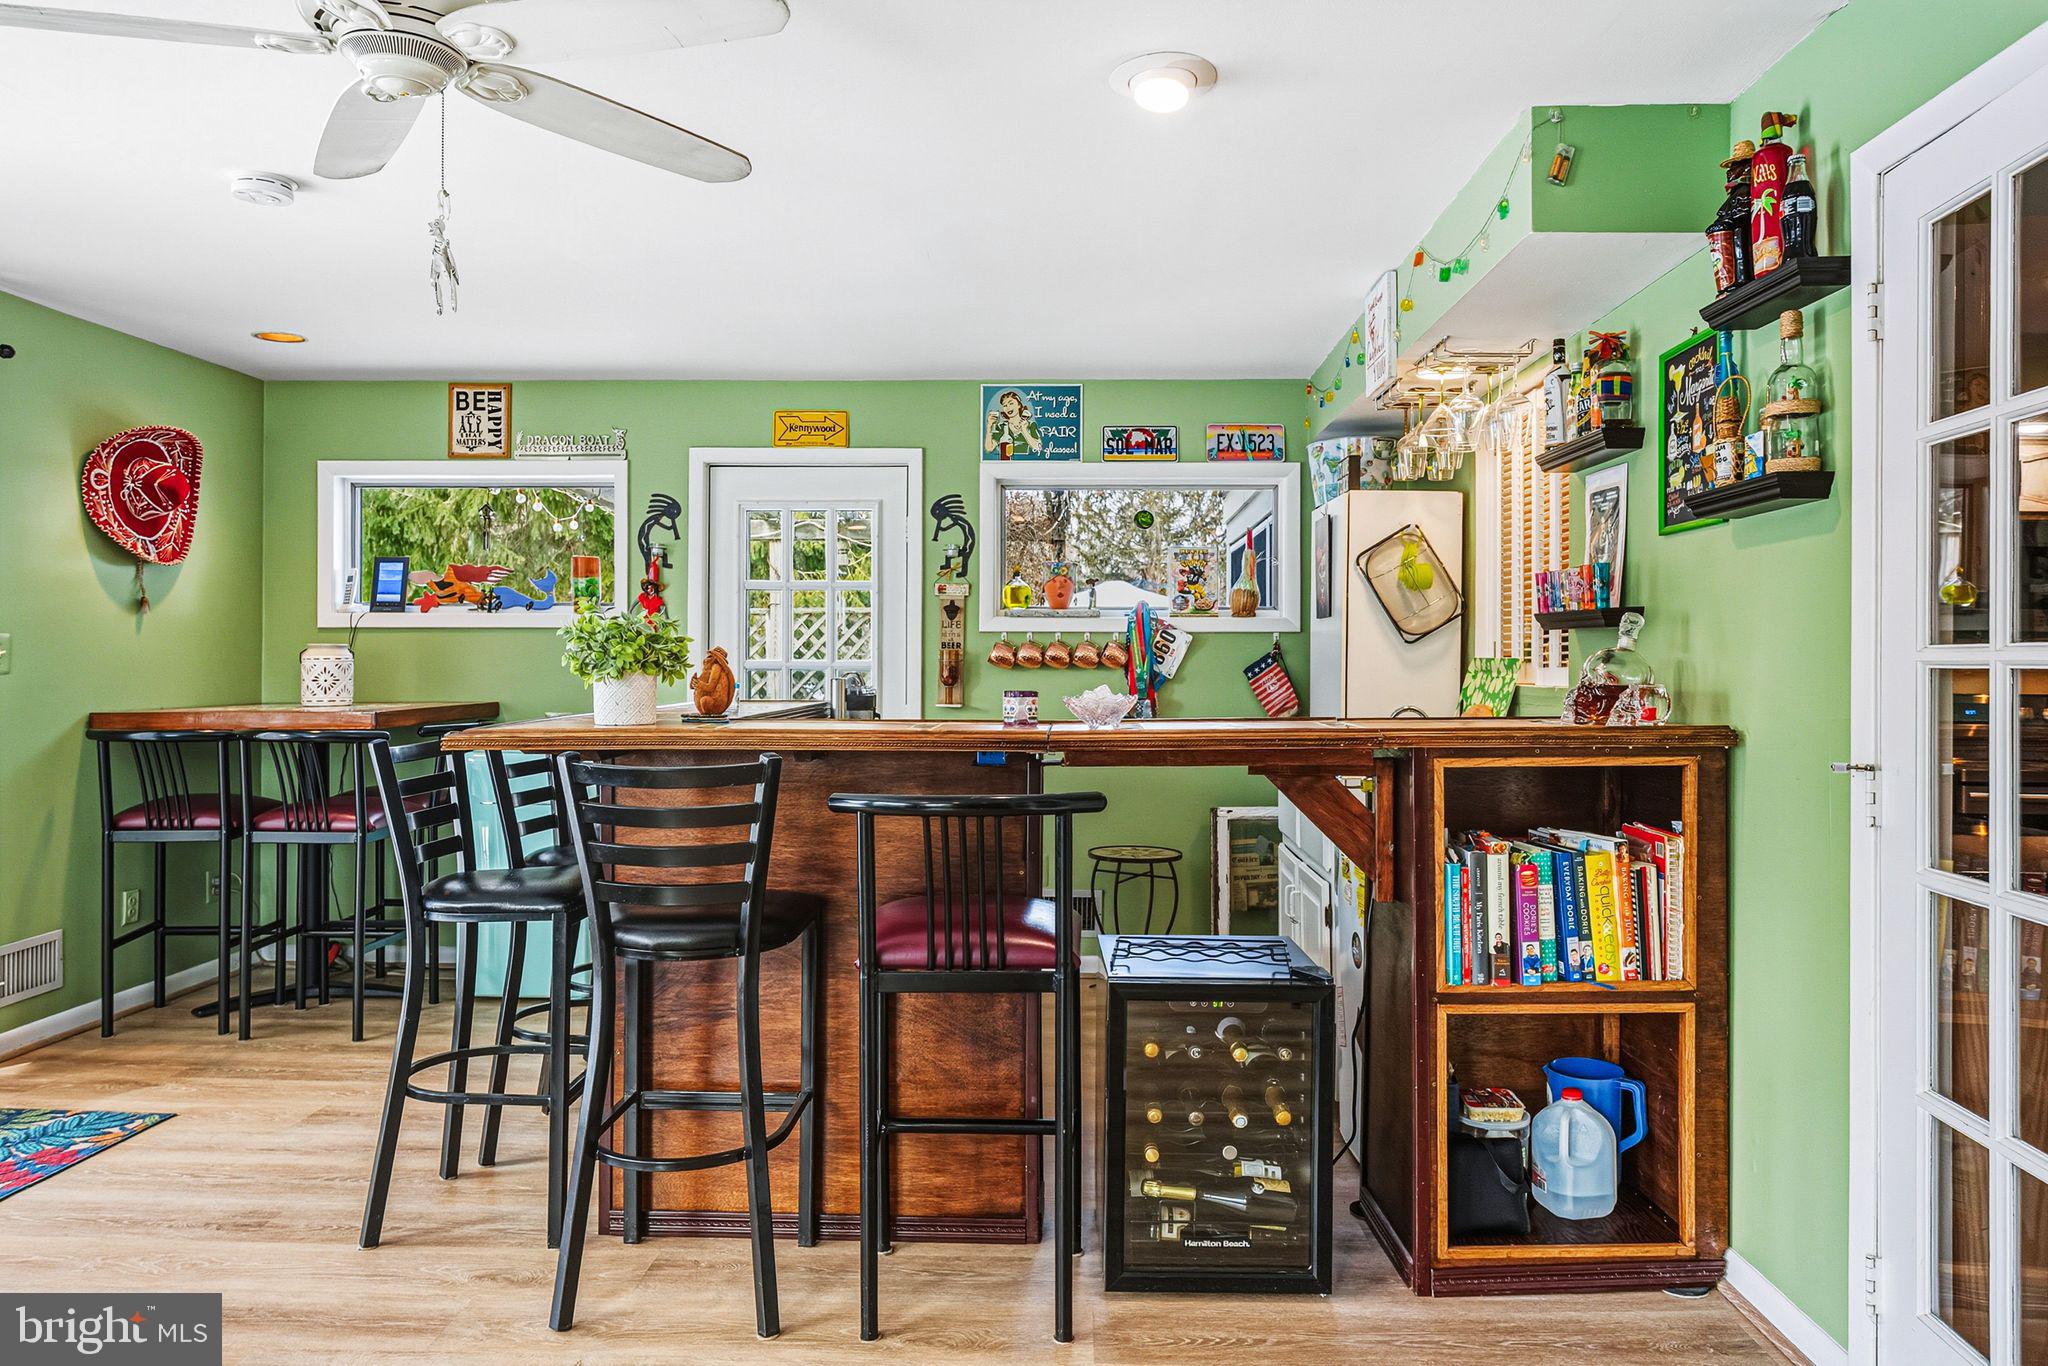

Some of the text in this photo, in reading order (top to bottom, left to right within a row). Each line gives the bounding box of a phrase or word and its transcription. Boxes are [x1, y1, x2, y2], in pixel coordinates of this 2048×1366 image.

[456, 391, 486, 411] BE
[1026, 390, 1078, 408] At my age,
[461, 416, 482, 424] IT'S
[487, 391, 502, 449] HAPPY
[1034, 406, 1043, 418] I
[1044, 406, 1068, 419] need
[459, 423, 482, 433] ALL
[788, 423, 836, 434] Kennywood
[1038, 425, 1077, 438] PAIR
[456, 438, 487, 446] MATTERS
[526, 434, 610, 446] DRAGON BOAT
[1106, 436, 1173, 455] SOL MAR
[1031, 441, 1078, 459] of glasses!
[941, 620, 962, 629] LIFE
[941, 641, 962, 650] BEER
[1577, 865, 1586, 898] BAKING
[1621, 866, 1630, 899] BAKING
[1562, 861, 1576, 931] EVERYDAY DORIE
[1474, 901, 1483, 911] My
[1595, 885, 1615, 926] quick
[1522, 902, 1531, 936] COOKIES
[1529, 904, 1537, 934] DORIE'S
[1580, 908, 1590, 935] DORIE
[1624, 919, 1632, 942] JULIA
[1476, 929, 1484, 954] Kitchen
[1603, 933, 1617, 971] easy
[1184, 1239, 1222, 1248] Hamilton
